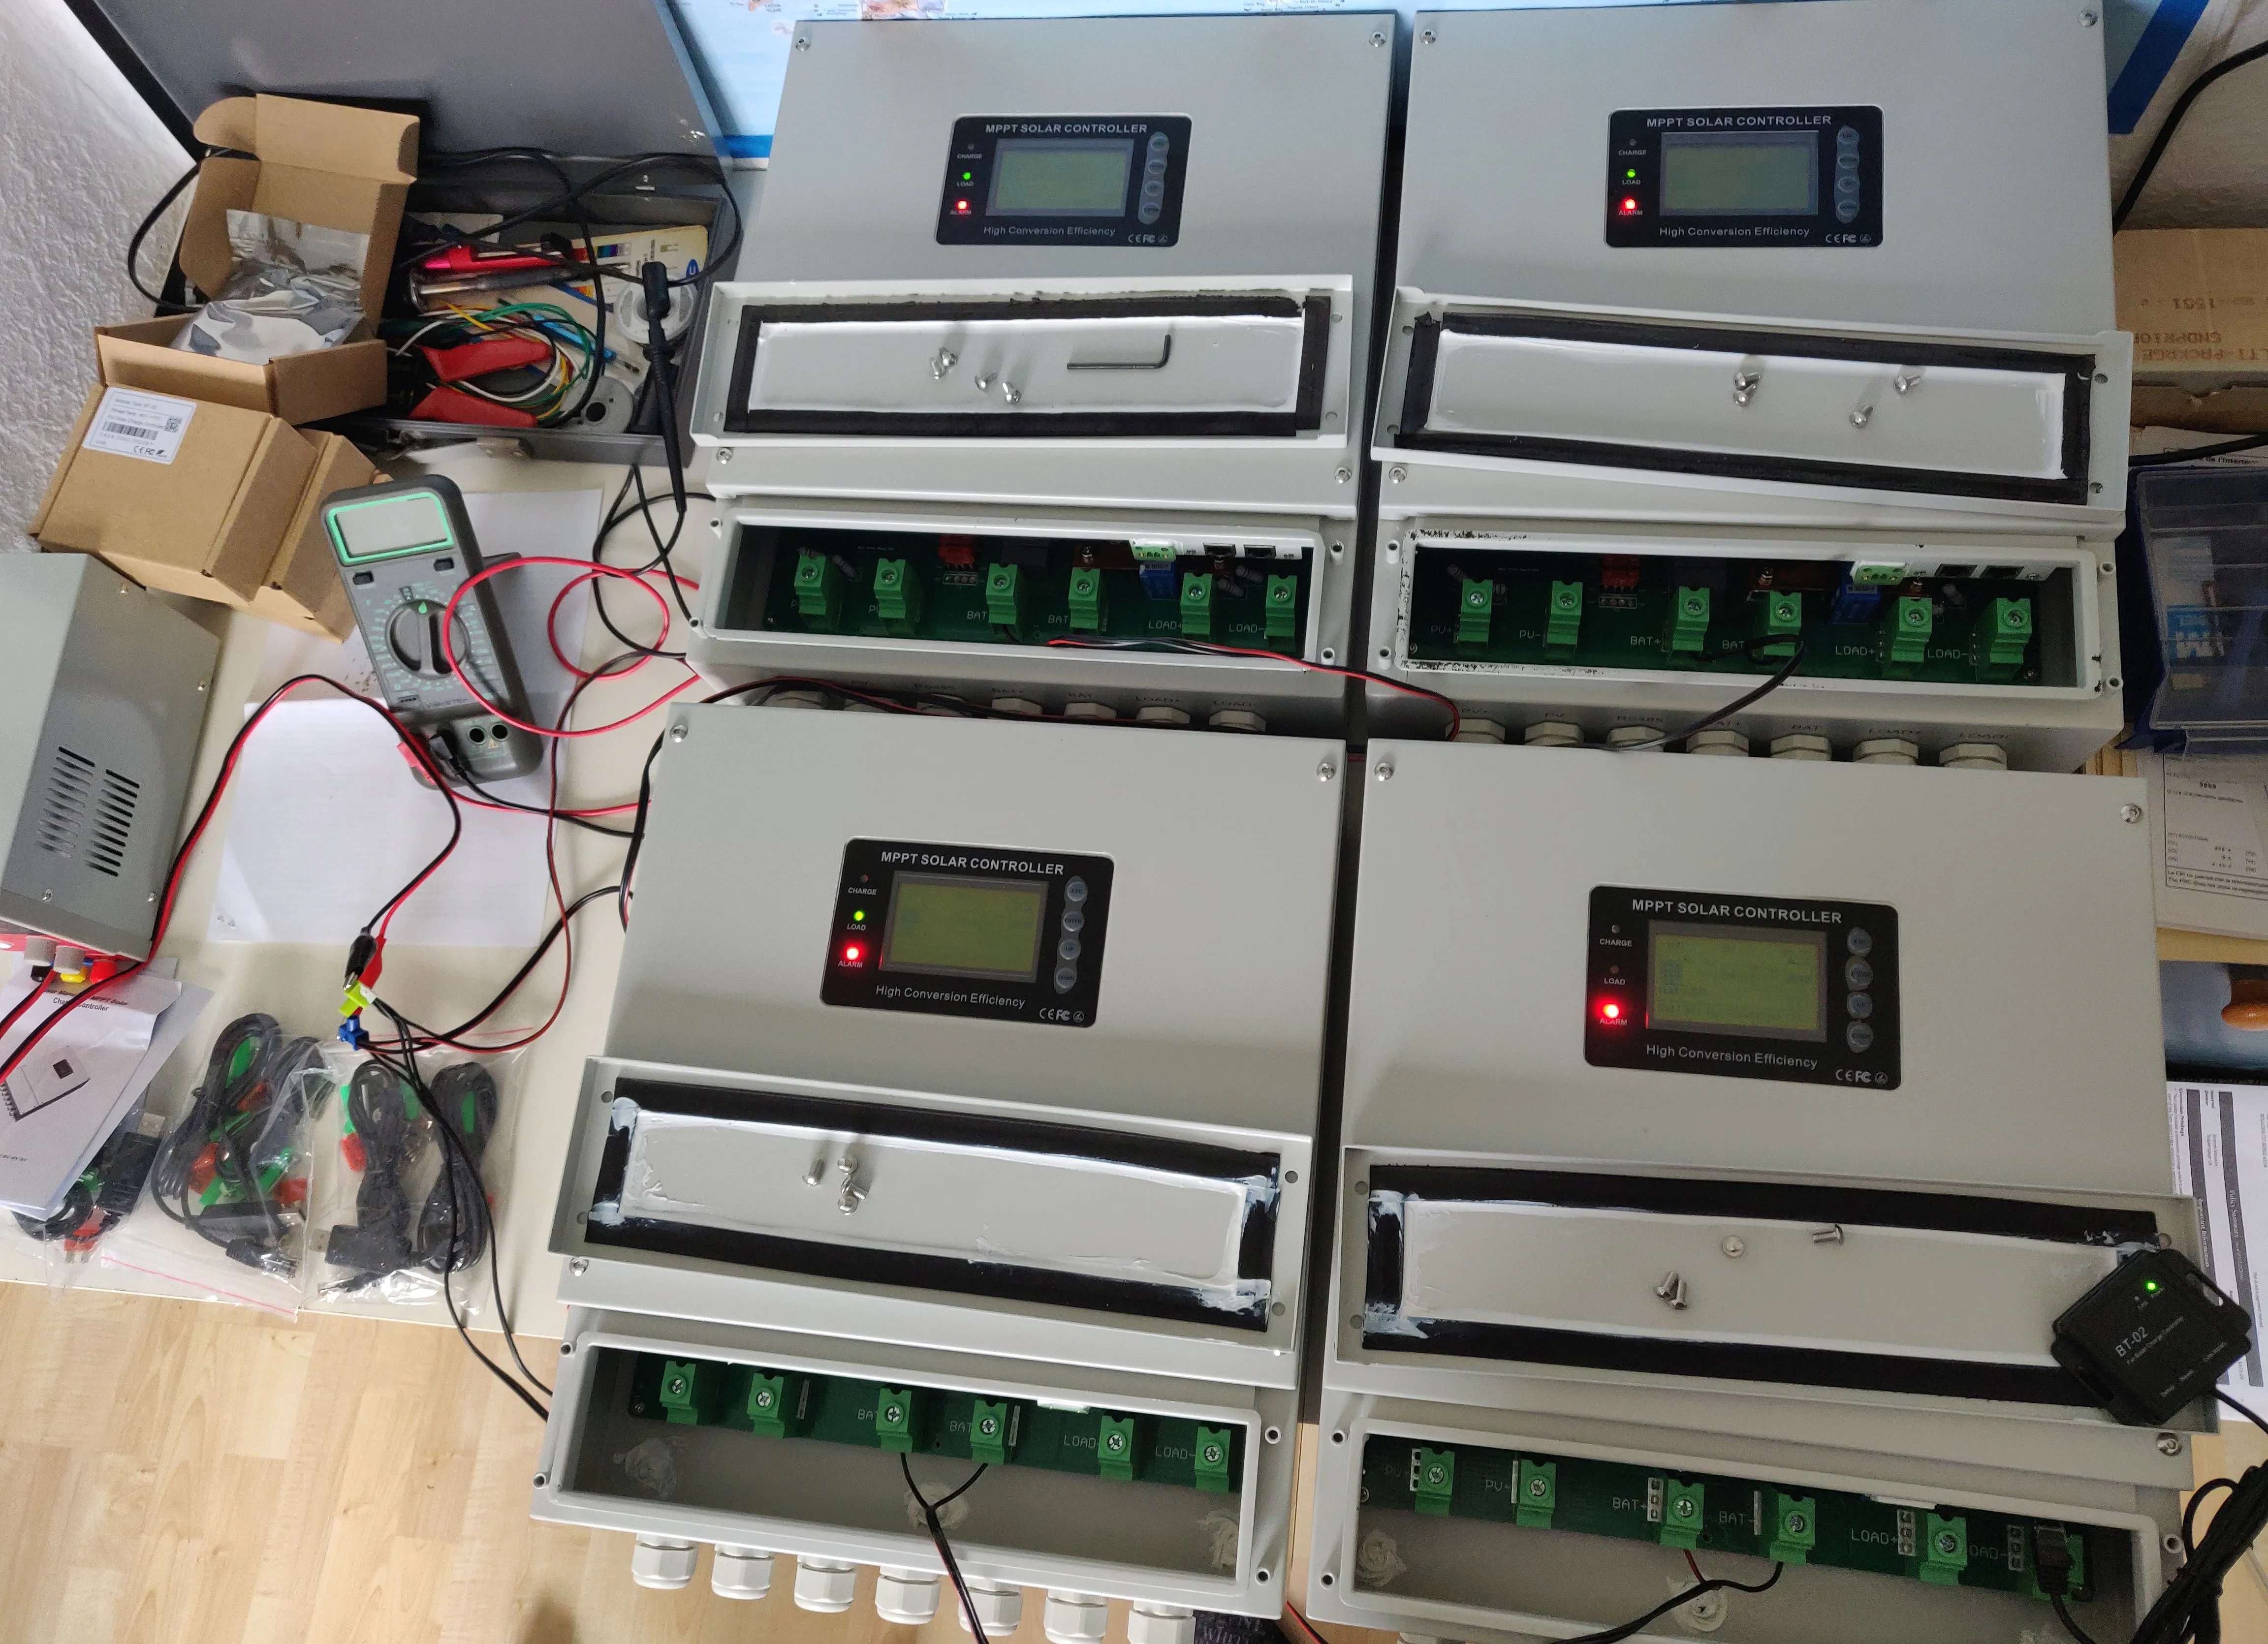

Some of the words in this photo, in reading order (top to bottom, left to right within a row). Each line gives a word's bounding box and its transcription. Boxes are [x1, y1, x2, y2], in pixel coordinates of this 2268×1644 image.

[1647, 118, 1684, 127] MPPT
[1687, 117, 1733, 127] SOLAR
[1737, 115, 1831, 126] CONTROLLER
[985, 124, 1018, 134] MPPT
[1020, 124, 1061, 134] SOLAR
[1065, 124, 1147, 133] CONTROLLER
[984, 226, 1006, 236] High
[1008, 226, 1064, 236] Conversion
[1067, 227, 1115, 238] Efficiency
[1659, 227, 1684, 237] High
[1688, 227, 1751, 237] Conversion
[1754, 226, 1810, 239] Efficiency
[1048, 614, 1069, 624] BAT
[1630, 636, 1661, 646] BAT+
[1835, 646, 1876, 656] LOAD+
[1927, 649, 1969, 659] LOAD-
[881, 851, 918, 865] MPPT
[920, 854, 967, 869] SOLAR
[970, 858, 1064, 876] CONTROLLER
[848, 887, 877, 896] CHARGE
[1632, 898, 1674, 914] MPPT
[1677, 901, 1731, 917] SOLAR
[1734, 905, 1842, 924] CONTROLLER
[1599, 938, 1633, 947] CHARGE
[838, 960, 863, 969] ALARM
[876, 985, 901, 998] High
[904, 987, 967, 1003] Conversion
[970, 993, 1026, 1009] Efficiency
[77, 1002, 109, 1012] ontroller
[1599, 1018, 1628, 1026] ALARM
[1646, 1044, 1675, 1058] High
[1678, 1046, 1751, 1063] Conversion
[1754, 1052, 1819, 1071] Efficiency
[2114, 1326, 2149, 1358] BT-02
[1063, 1434, 1099, 1449] LOAD
[1612, 1497, 1648, 1511] BAT+
[1851, 1527, 1899, 1545] LOAD+
[1969, 1543, 2008, 1560] OAD-
